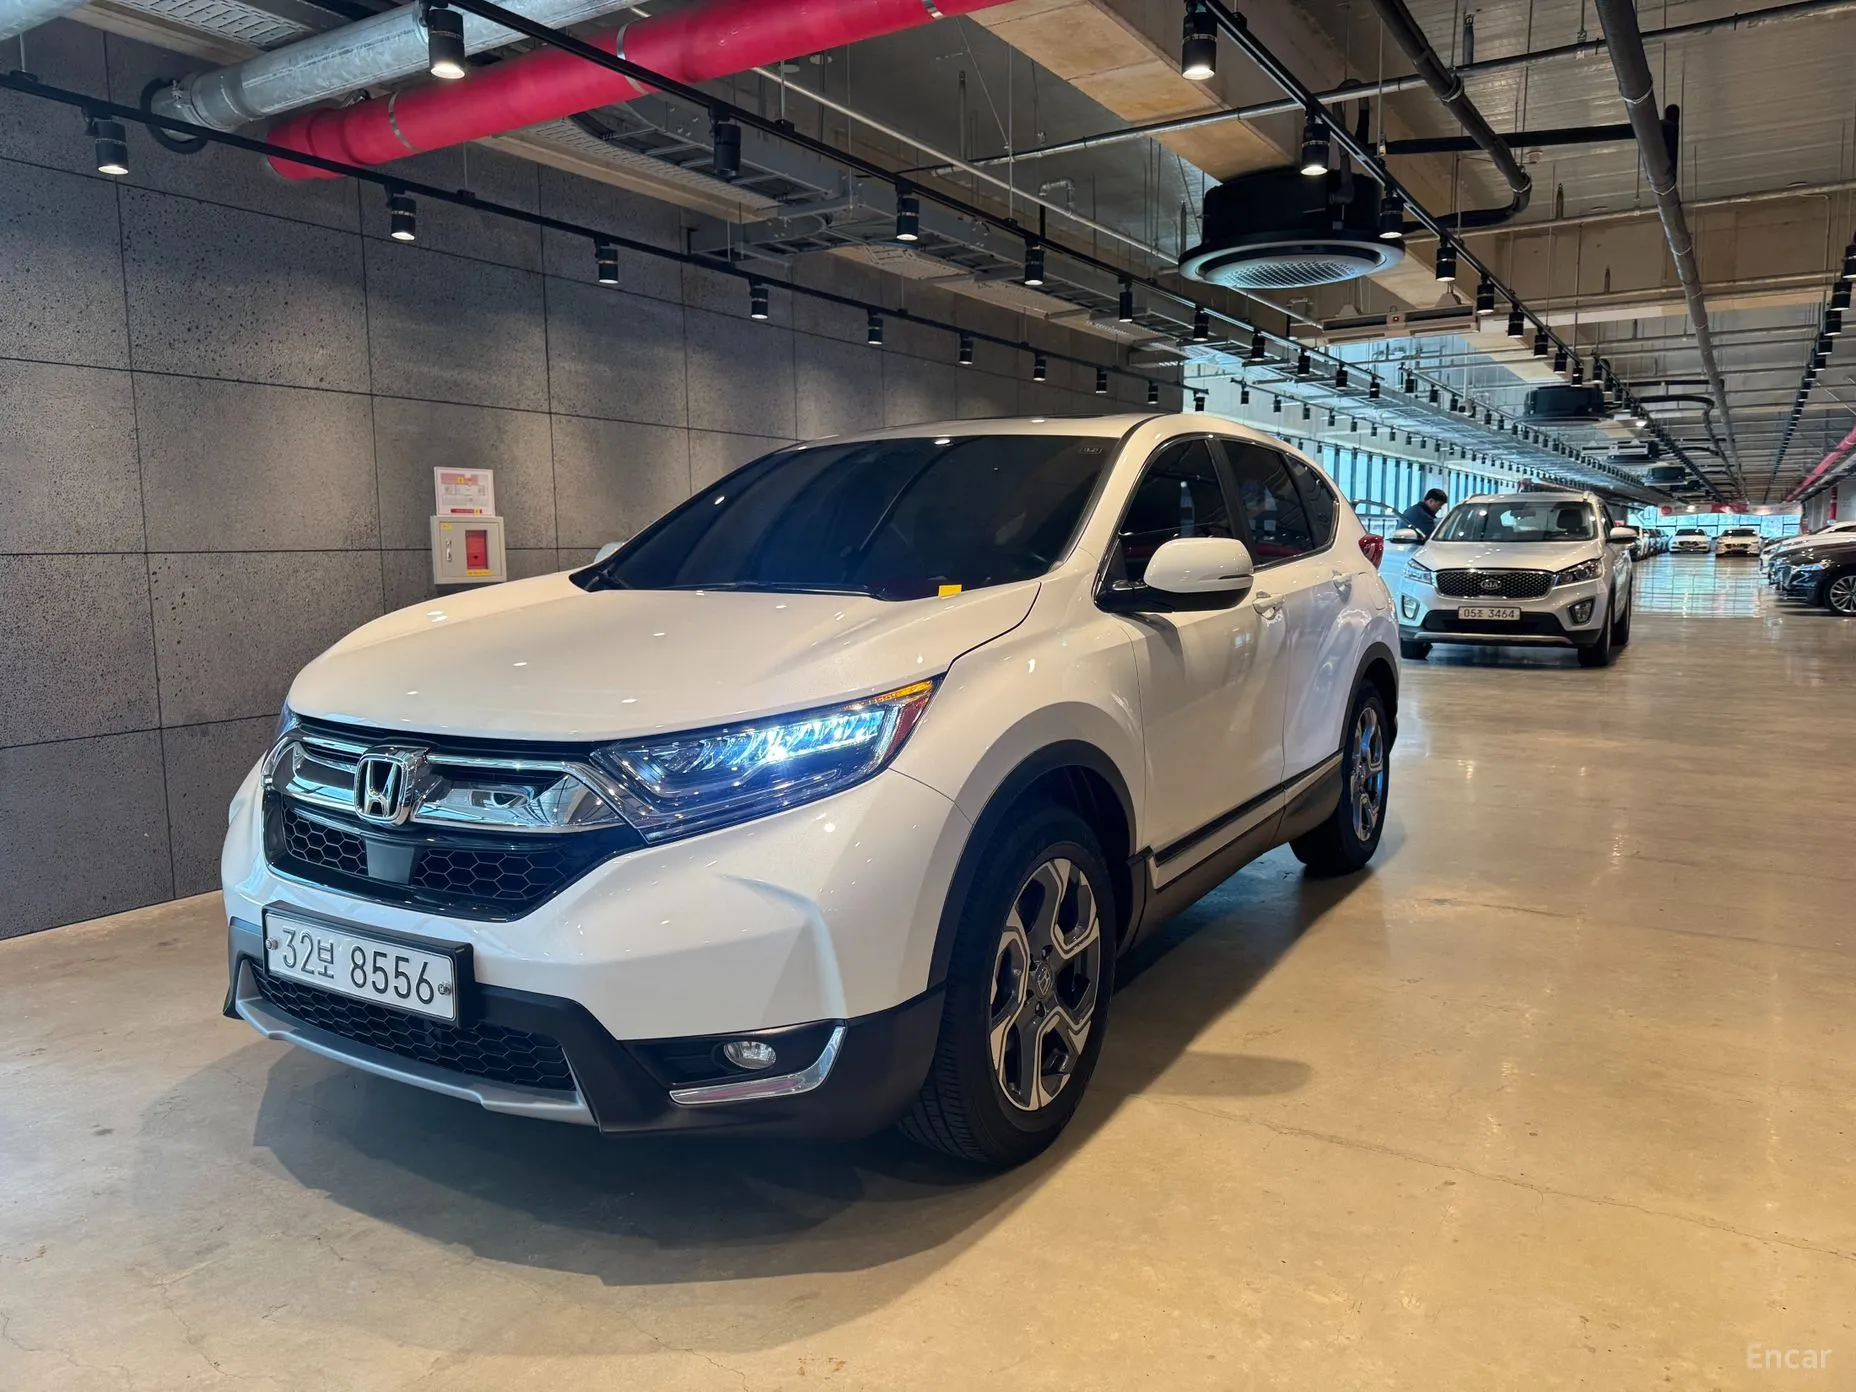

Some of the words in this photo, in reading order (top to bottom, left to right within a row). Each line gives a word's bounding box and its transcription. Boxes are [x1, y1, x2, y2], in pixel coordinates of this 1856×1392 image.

[1488, 608, 1515, 619] 3464
[282, 928, 334, 979] 32보
[350, 946, 434, 1005] 8556
